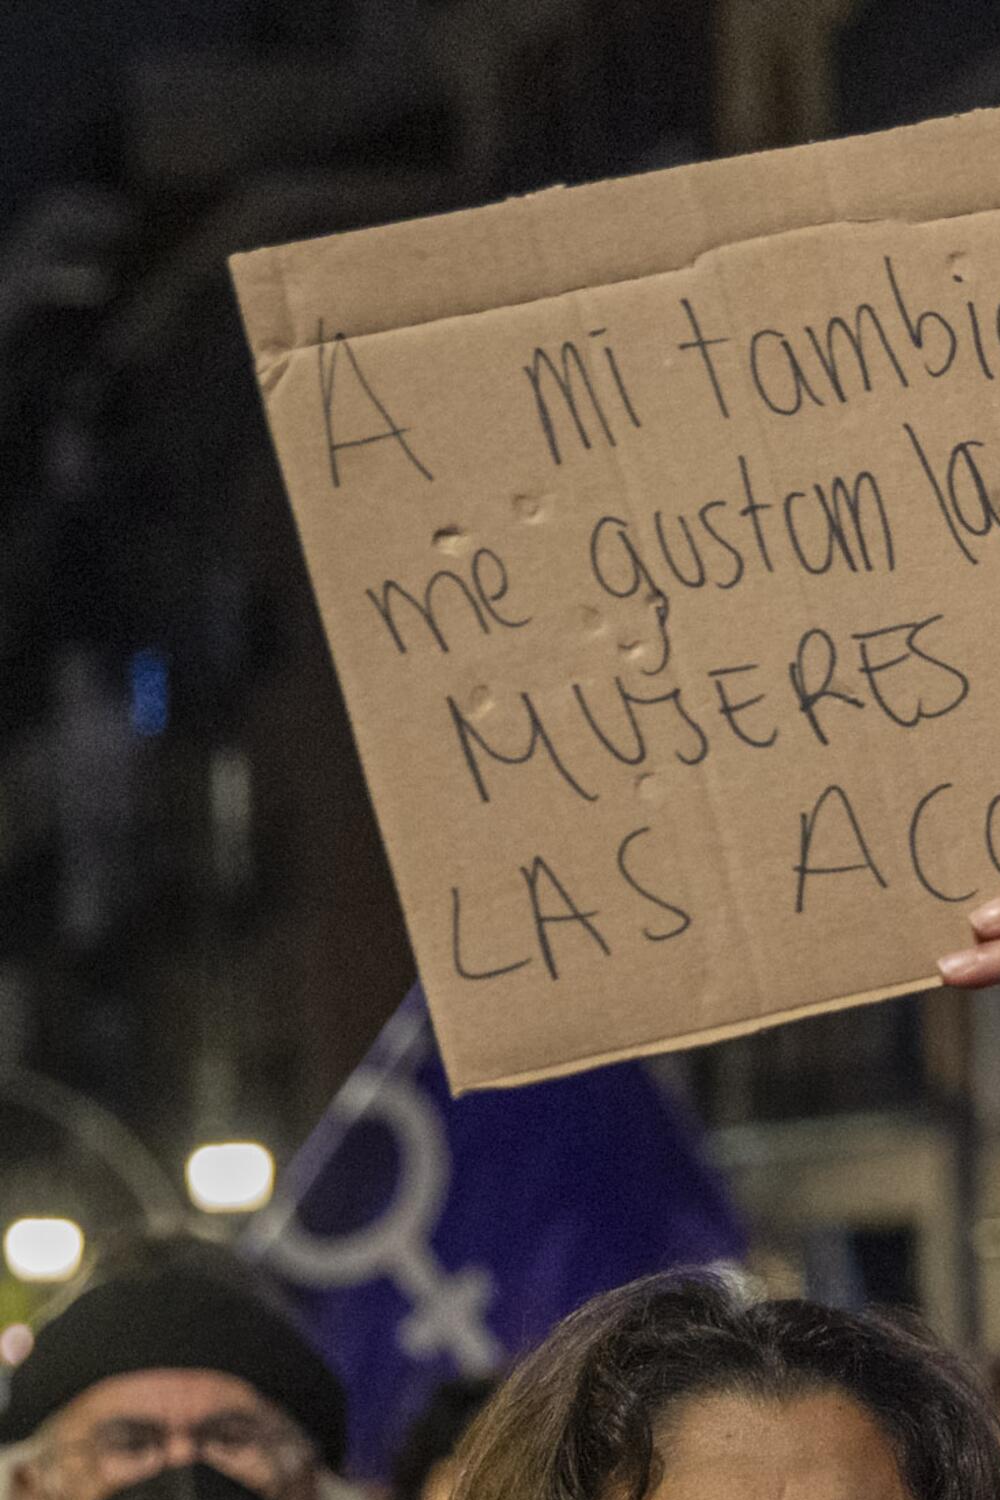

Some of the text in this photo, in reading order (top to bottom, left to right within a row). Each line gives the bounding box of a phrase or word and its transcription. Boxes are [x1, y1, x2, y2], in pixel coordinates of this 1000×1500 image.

[316, 316, 434, 488] A
[365, 547, 533, 654] me
[589, 454, 896, 676] gustan
[446, 614, 970, 804] MUJERES
[451, 826, 693, 981] LAS
